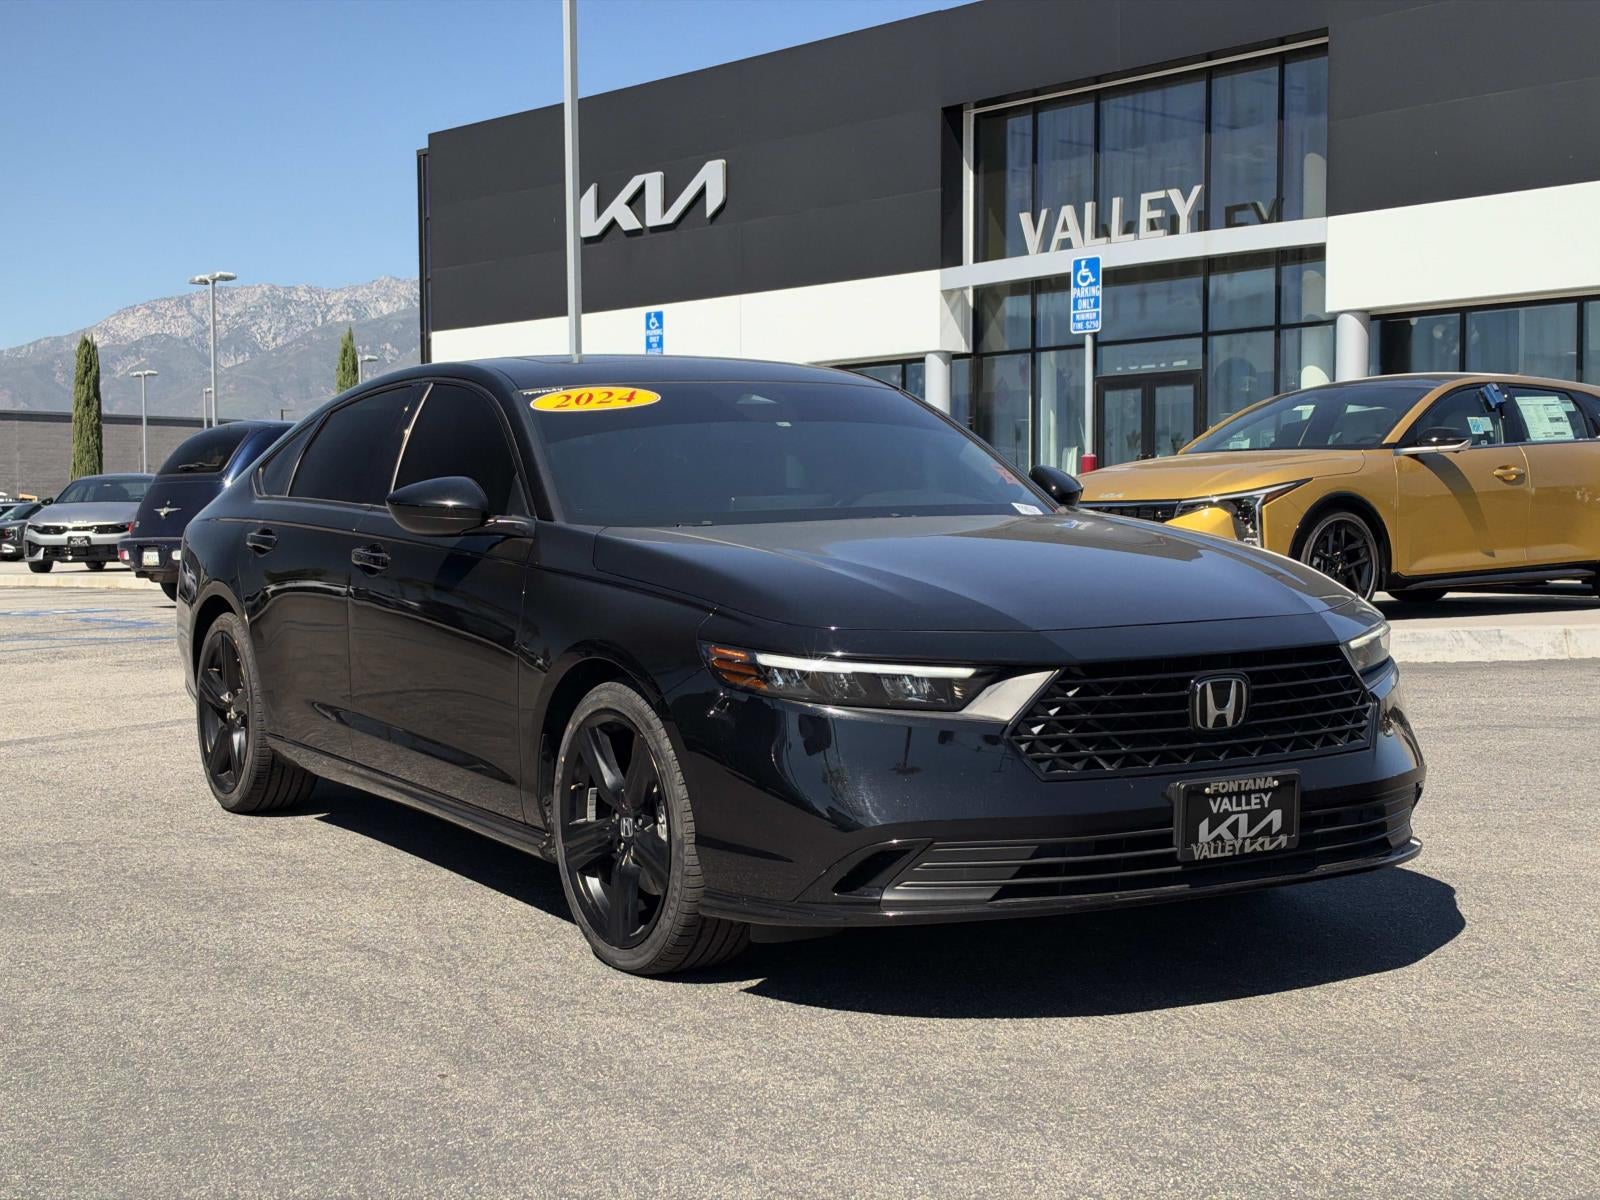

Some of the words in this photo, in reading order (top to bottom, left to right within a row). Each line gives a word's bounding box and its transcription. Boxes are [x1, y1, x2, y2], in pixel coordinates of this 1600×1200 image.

[580, 159, 726, 238] KIA
[1019, 185, 1205, 255] VALLEY
[1073, 285, 1100, 299] PARKING
[1077, 298, 1095, 310] ONLY
[1075, 312, 1097, 322] MINIMUM
[553, 390, 637, 409] 2024
[1210, 777, 1274, 794] FONTANA
[1209, 792, 1273, 814] VALLEY
[1199, 809, 1282, 843] KIA
[1191, 839, 1244, 861] VALLEY
